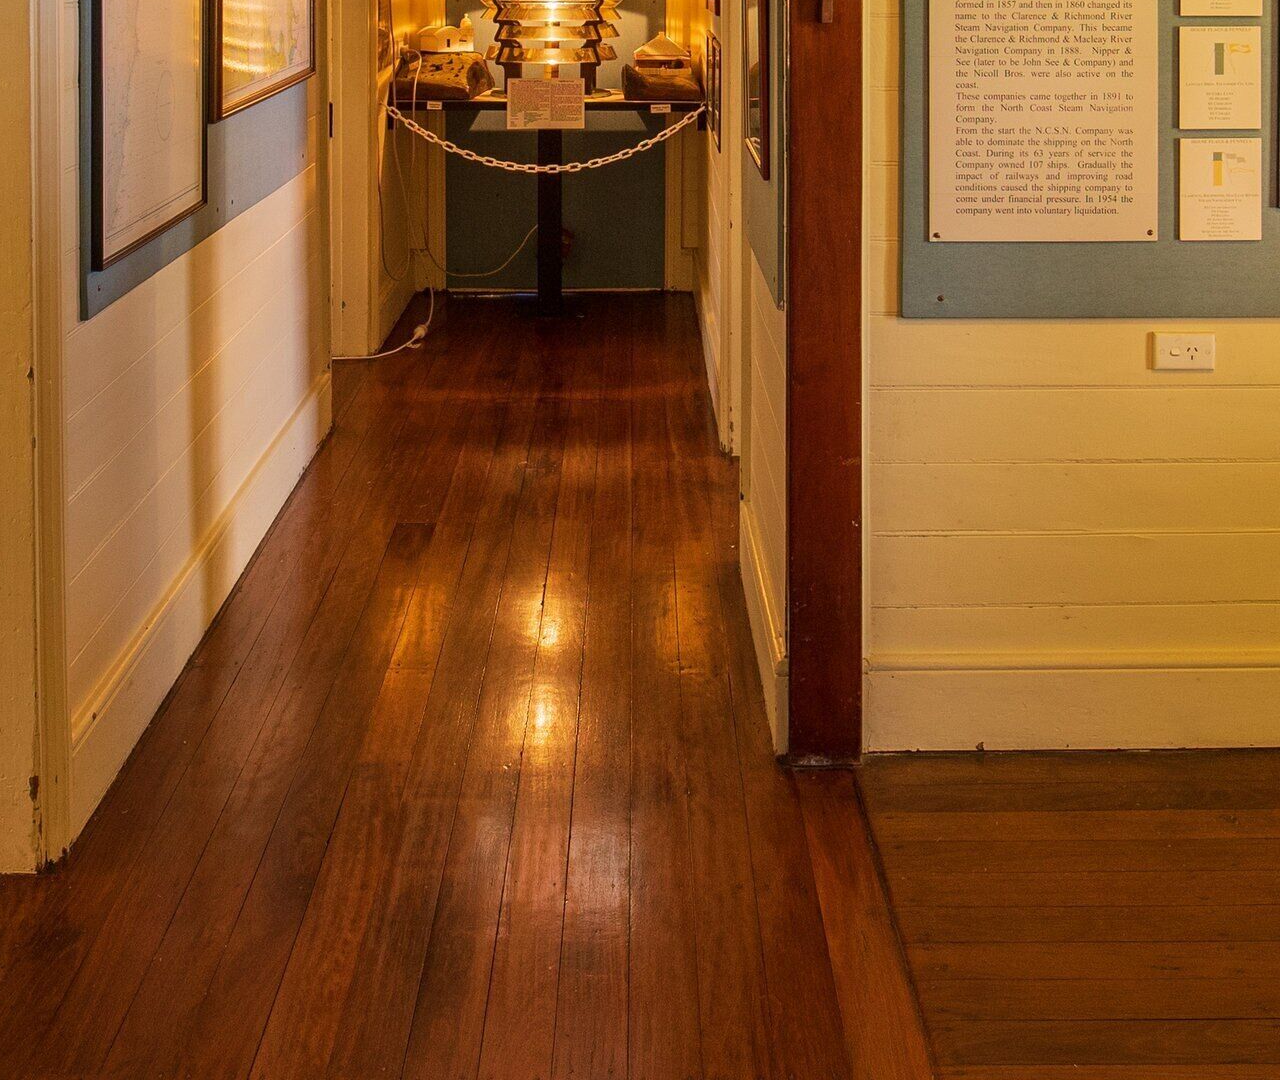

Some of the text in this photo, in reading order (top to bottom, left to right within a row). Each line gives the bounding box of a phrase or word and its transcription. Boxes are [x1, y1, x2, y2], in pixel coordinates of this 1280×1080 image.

[955, 0, 1133, 11] formed in 1857 and then in 1860 changed its
[981, 12, 990, 20] to
[994, 12, 1008, 20] the
[1011, 12, 1047, 20] Clarence
[1051, 12, 1059, 20] &
[1064, 12, 1106, 20] Richmond
[1110, 12, 1133, 20] River
